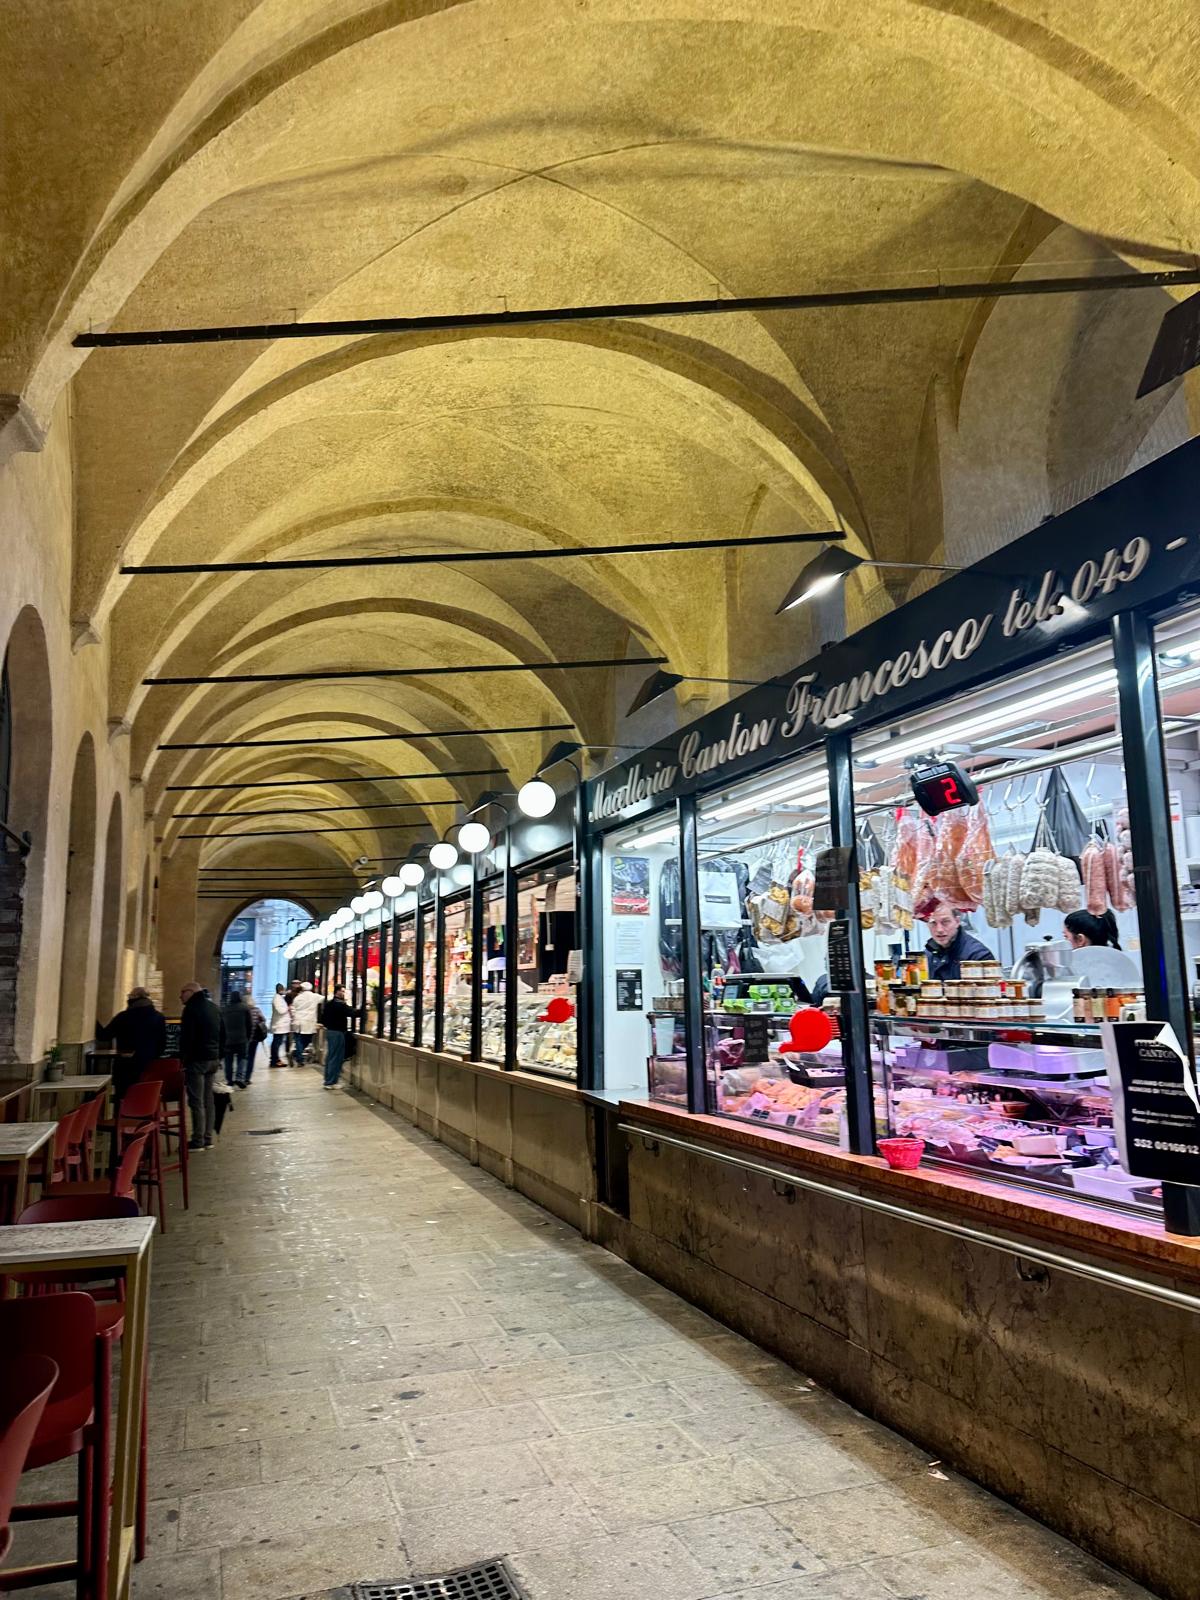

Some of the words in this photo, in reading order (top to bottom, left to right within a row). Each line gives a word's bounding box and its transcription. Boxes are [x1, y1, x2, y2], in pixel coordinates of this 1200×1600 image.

[588, 762, 678, 823] Macelleria
[678, 713, 777, 779] Canton
[781, 614, 993, 738] Francesco
[1002, 570, 1064, 637] tel.
[1071, 536, 1151, 603] 049
[941, 777, 962, 804] 2
